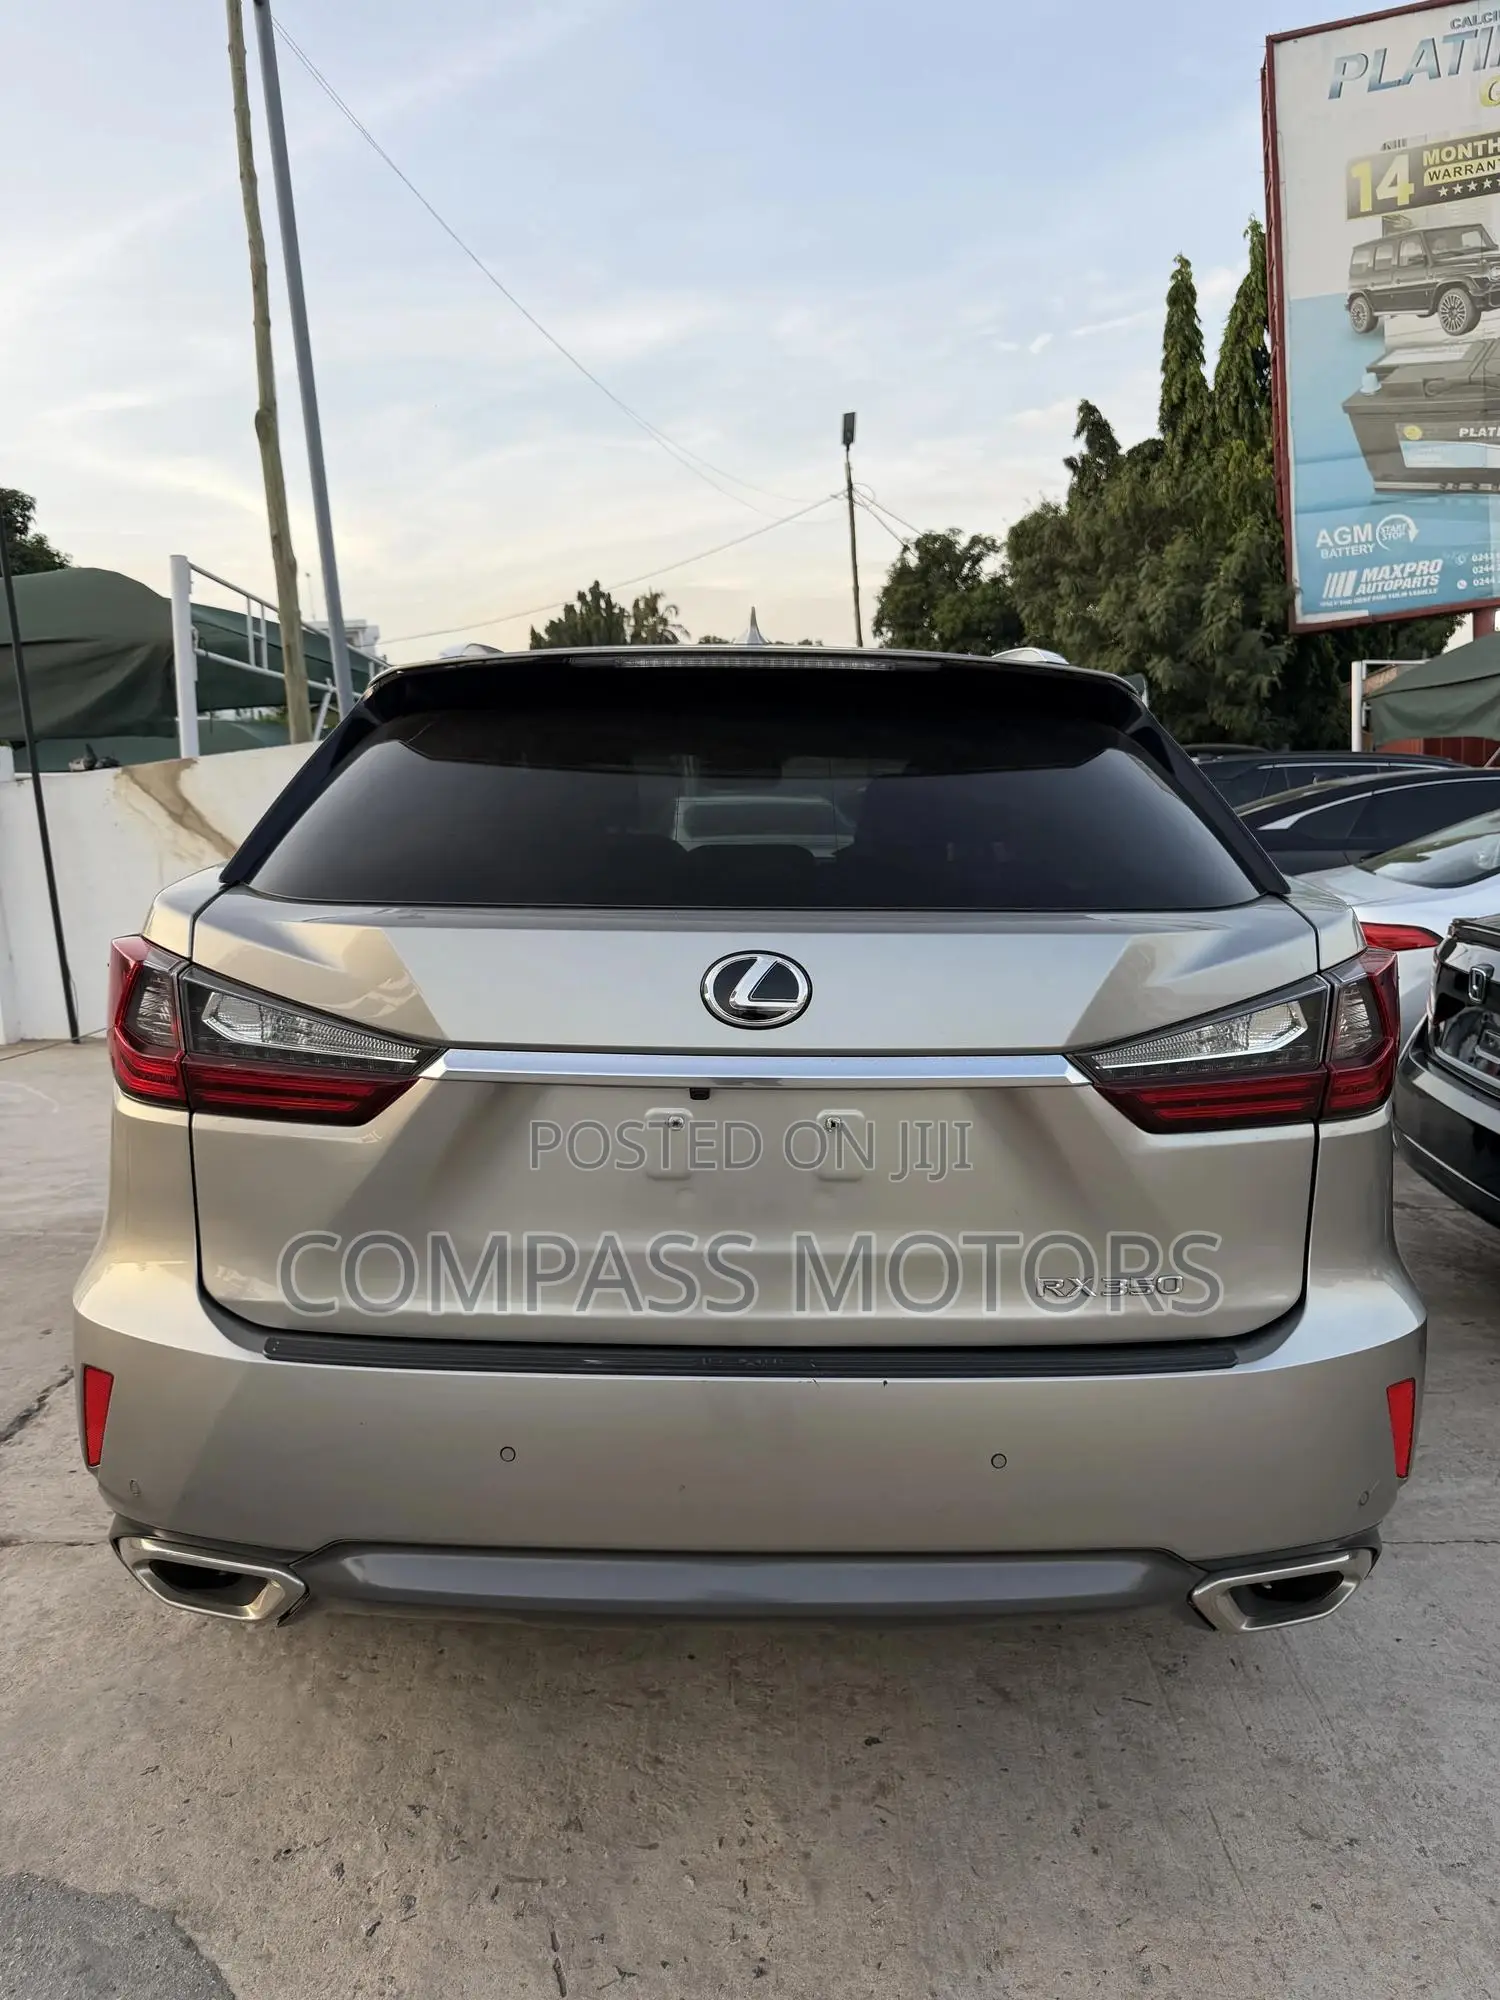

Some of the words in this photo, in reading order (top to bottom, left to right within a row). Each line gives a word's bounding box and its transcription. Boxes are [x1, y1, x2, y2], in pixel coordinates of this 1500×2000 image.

[1450, 9, 1500, 29] CALCI
[1428, 158, 1500, 182] WARRAN
[1351, 154, 1415, 212] 14
[1316, 522, 1373, 548] AGM
[1320, 543, 1376, 559] BATTERY
[1360, 559, 1444, 583] MAXPRO
[1355, 574, 1441, 596] AUTOPARTS
